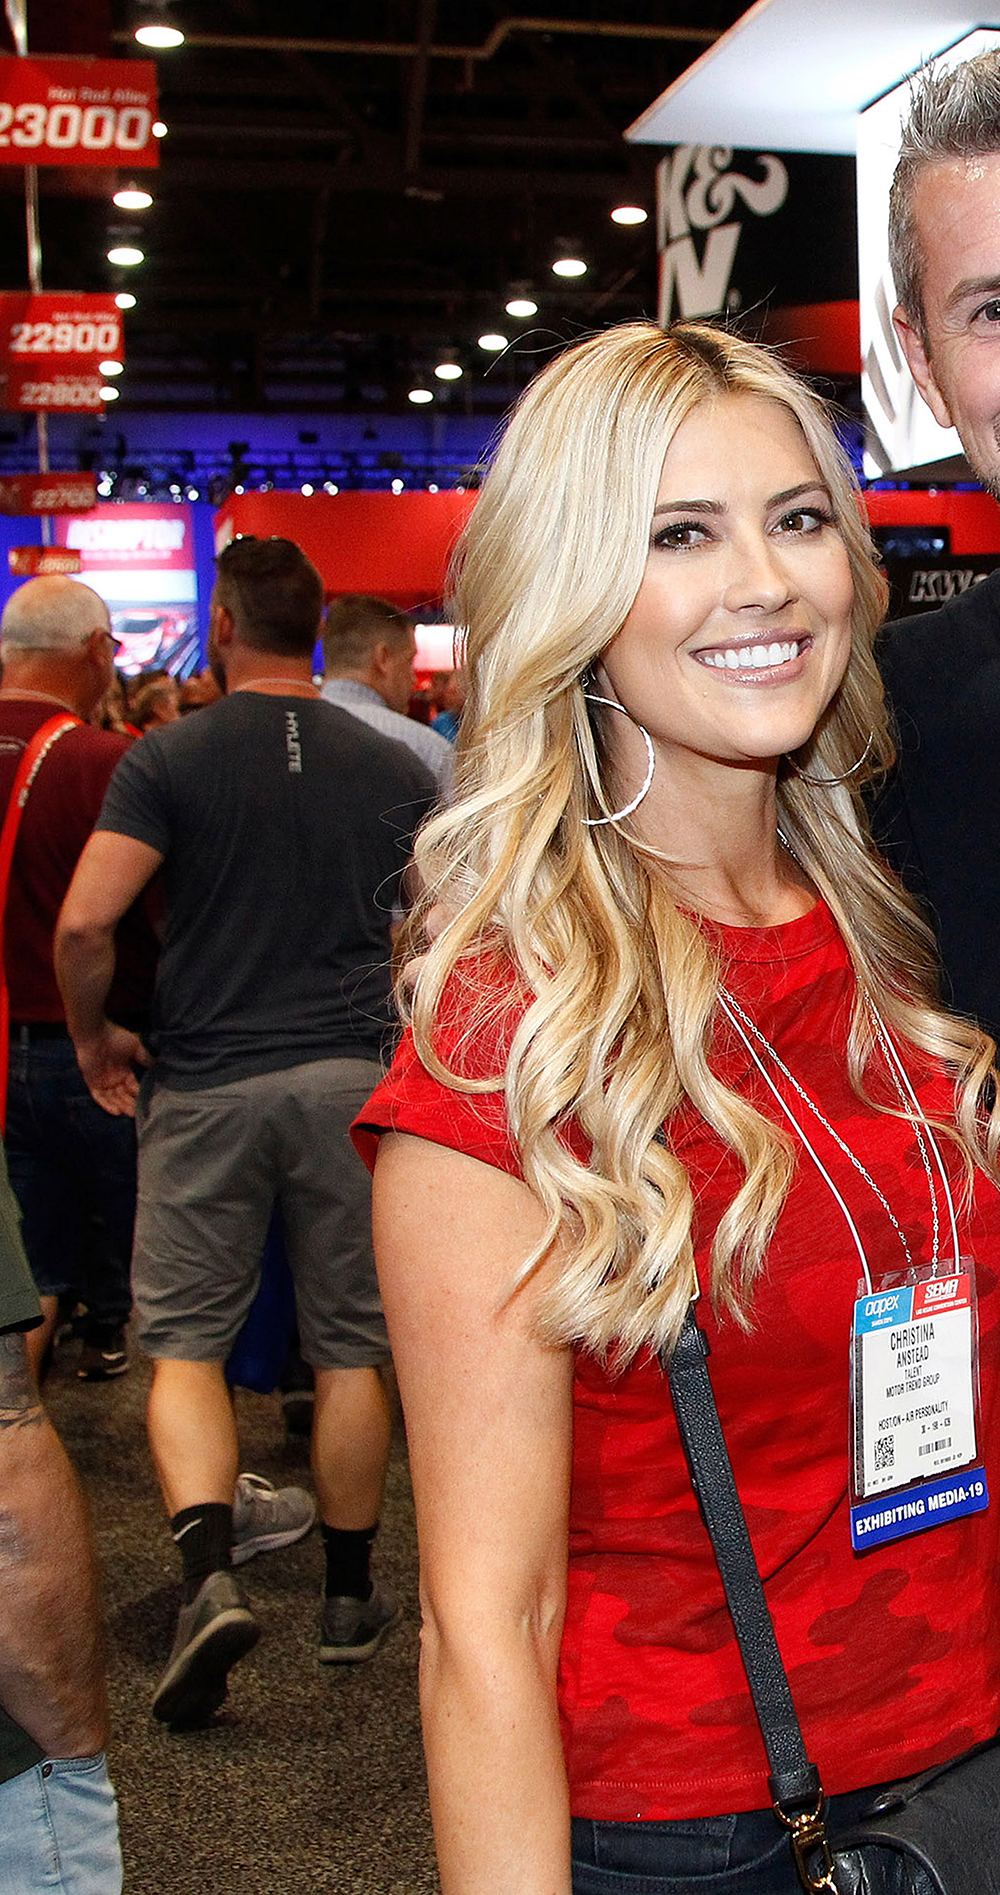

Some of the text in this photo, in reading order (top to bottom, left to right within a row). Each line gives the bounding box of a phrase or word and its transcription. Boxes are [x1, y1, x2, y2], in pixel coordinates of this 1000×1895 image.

[10, 322, 120, 353] 22900
[924, 1279, 959, 1299] SEMA
[865, 1294, 900, 1318] aapex
[890, 1322, 935, 1351] CHRISTINA
[896, 1345, 929, 1368] ANSTEAD
[904, 1365, 922, 1380] TALENT
[855, 1499, 925, 1536] EXHIBITING
